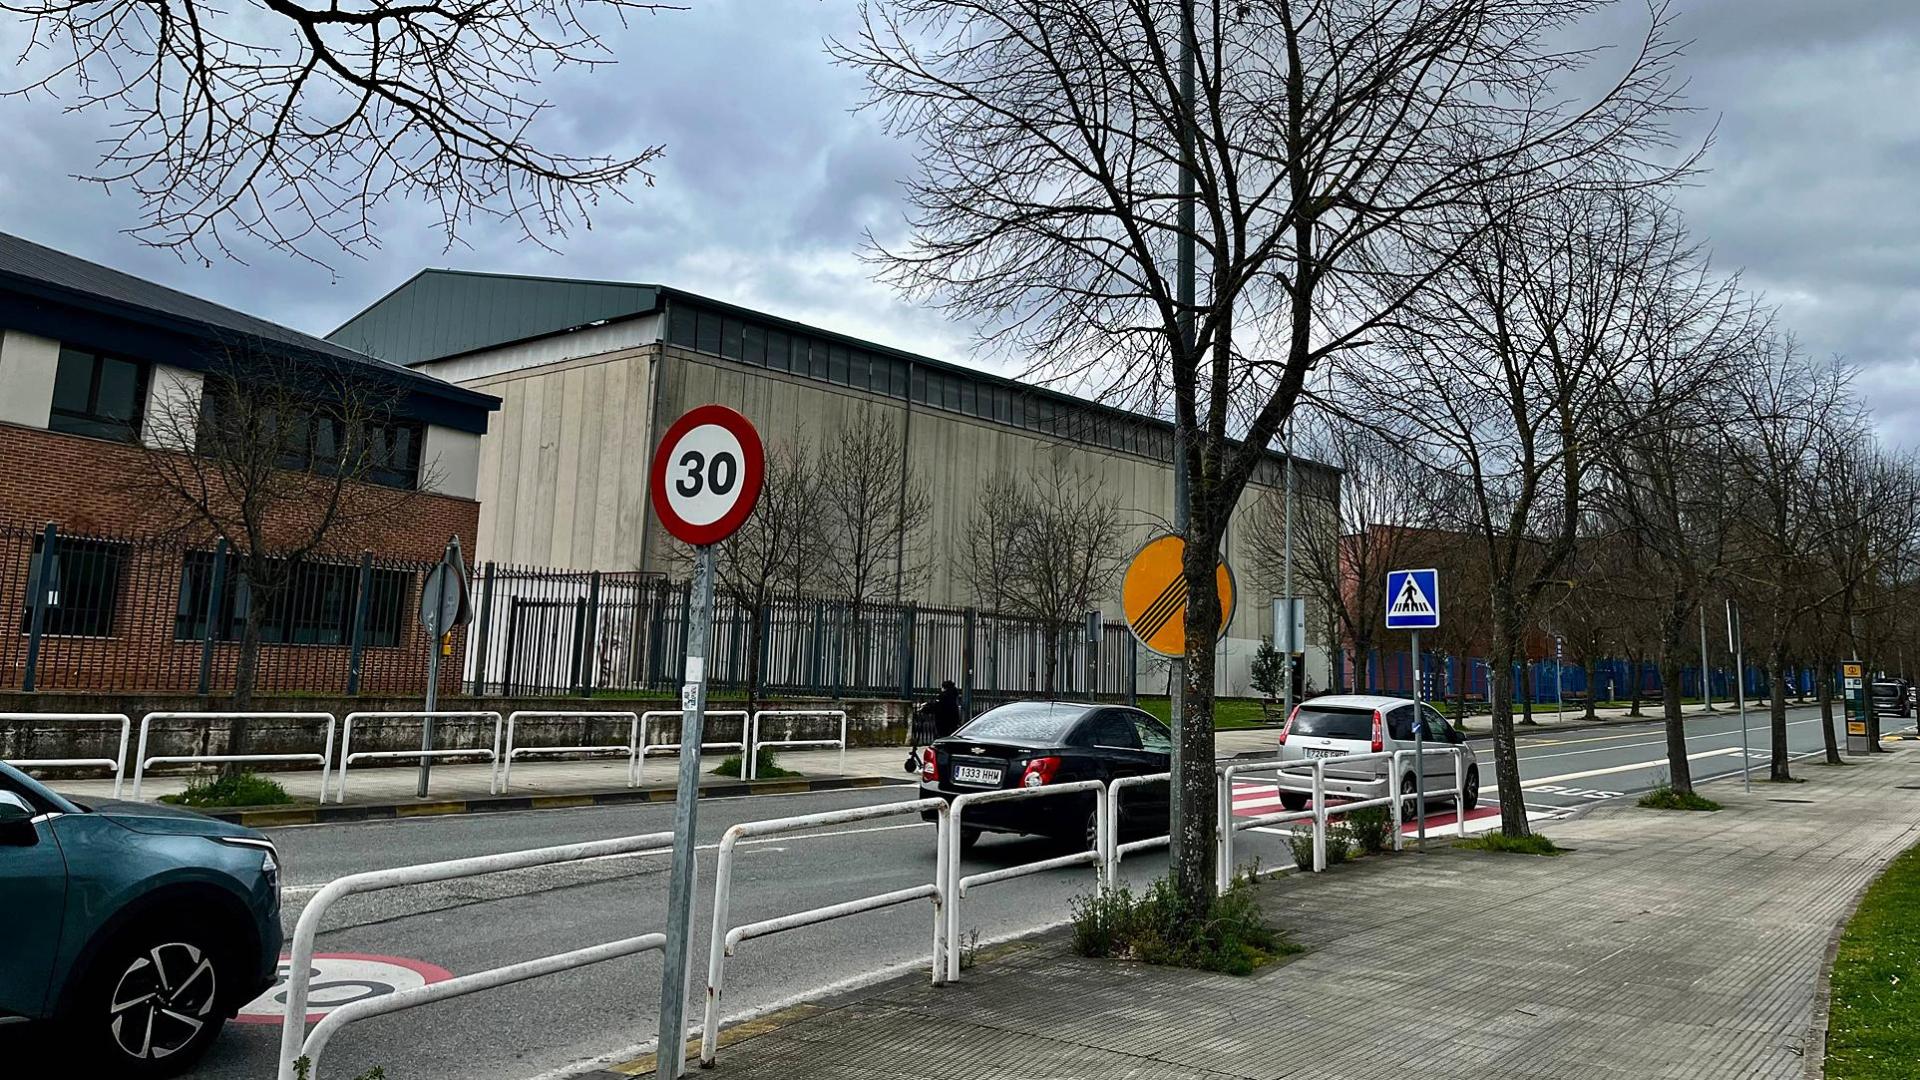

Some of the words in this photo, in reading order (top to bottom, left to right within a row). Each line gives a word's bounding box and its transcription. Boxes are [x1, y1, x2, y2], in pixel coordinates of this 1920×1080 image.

[676, 450, 737, 498] 30
[961, 767, 981, 779] 1333
[1521, 785, 1625, 799] BUS
